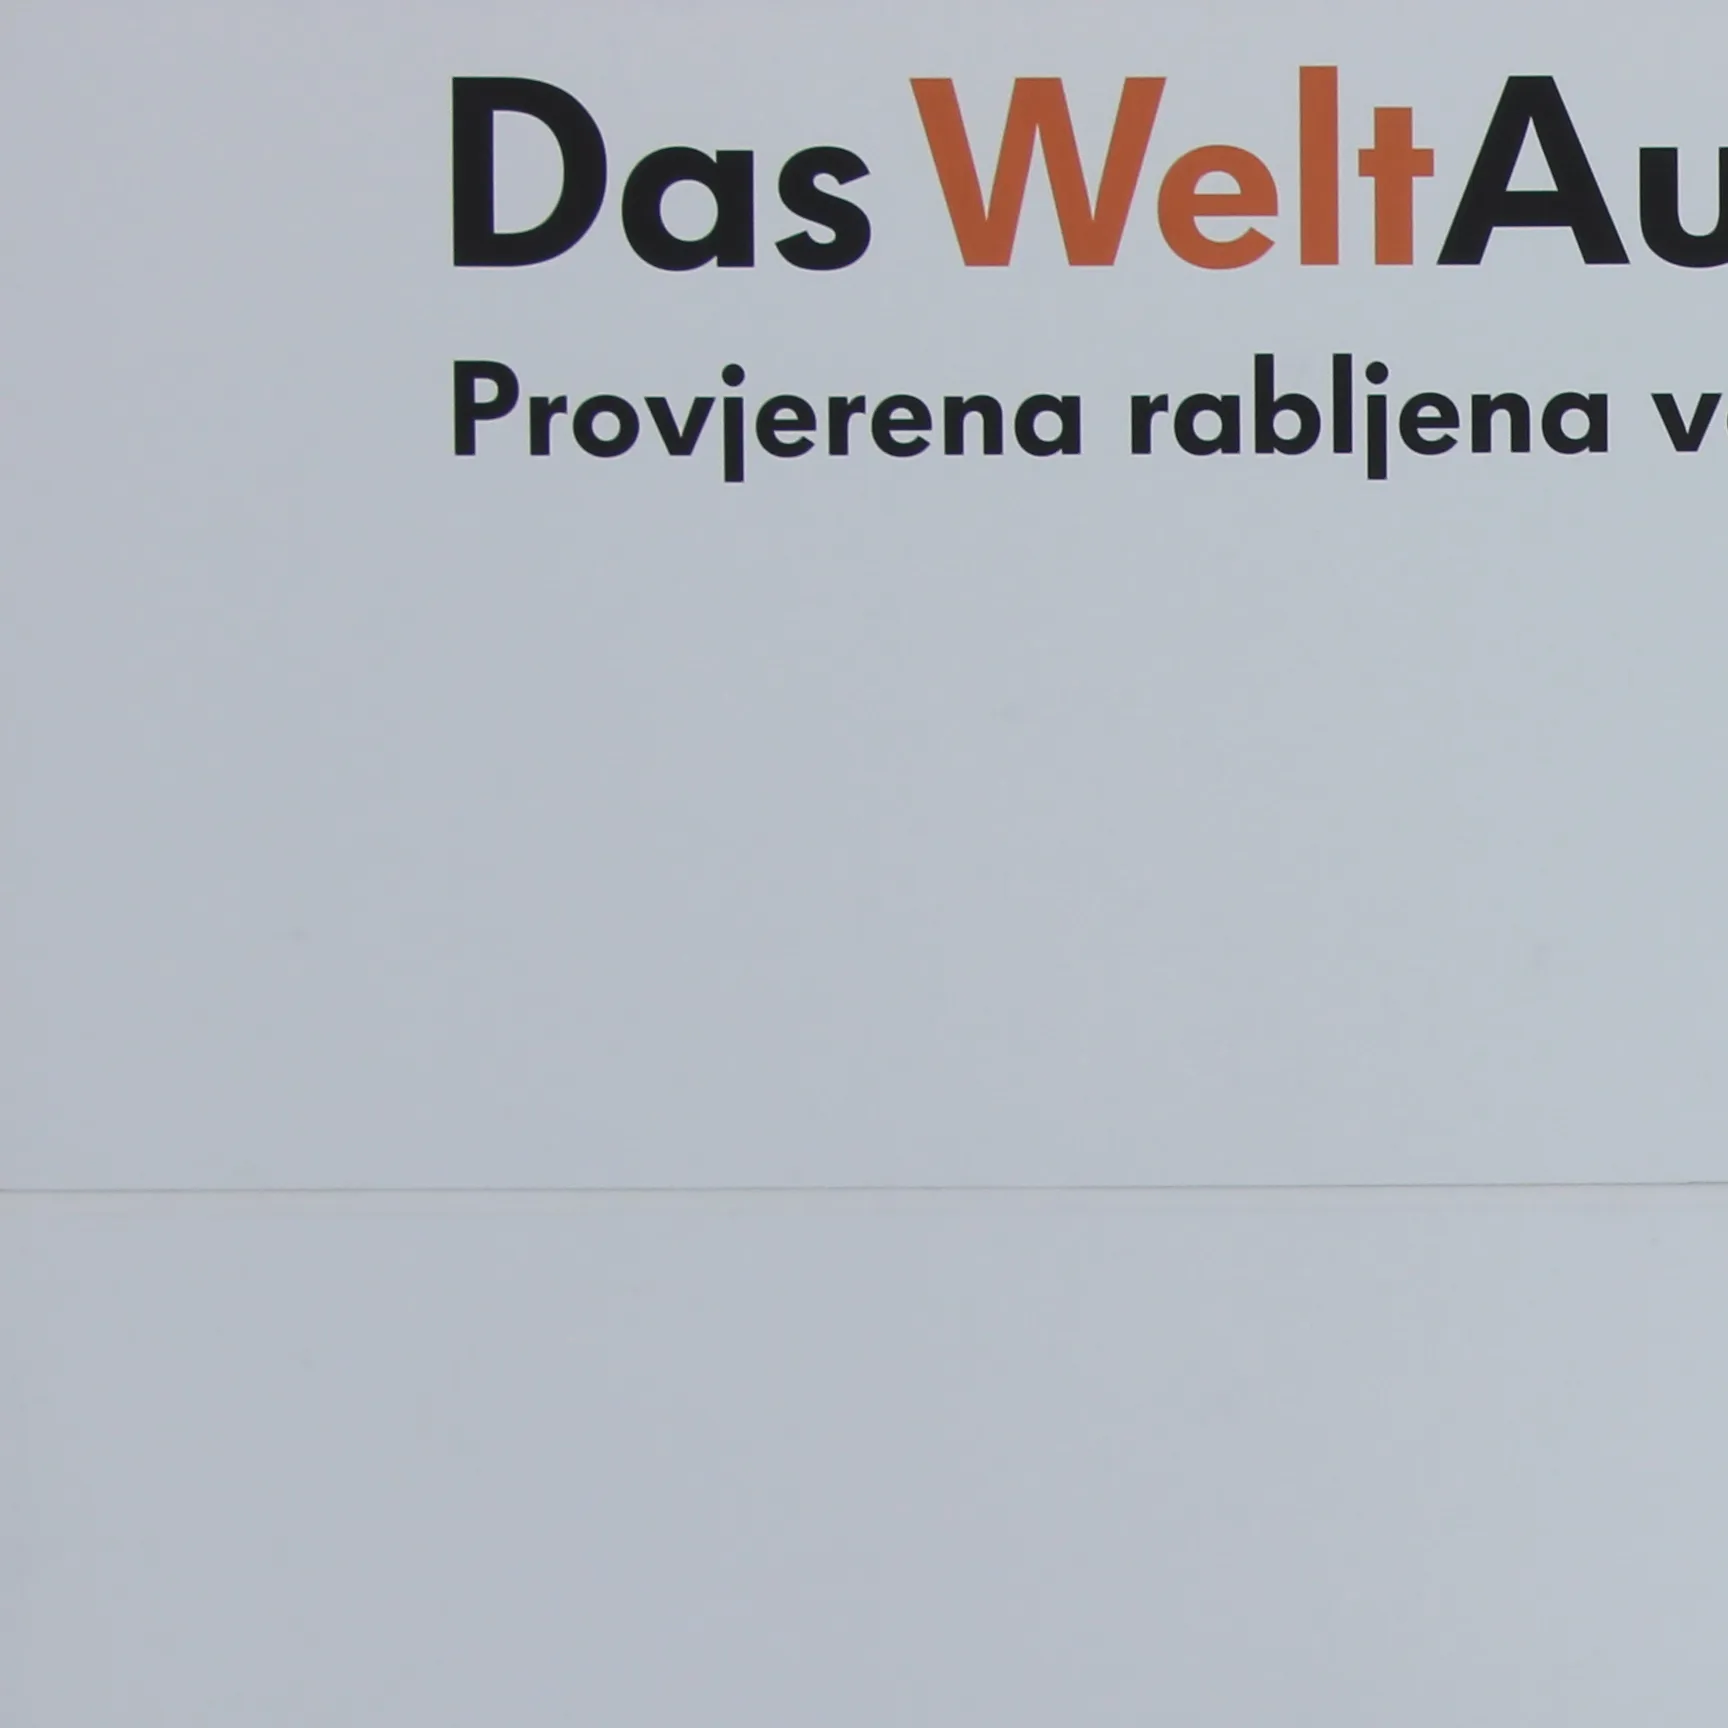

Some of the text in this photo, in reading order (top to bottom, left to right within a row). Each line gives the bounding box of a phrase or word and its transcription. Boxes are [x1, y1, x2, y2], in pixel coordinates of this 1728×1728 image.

[451, 76, 871, 272] Das
[453, 360, 1081, 483] Provjerena
[1130, 353, 1608, 480] rabljena
